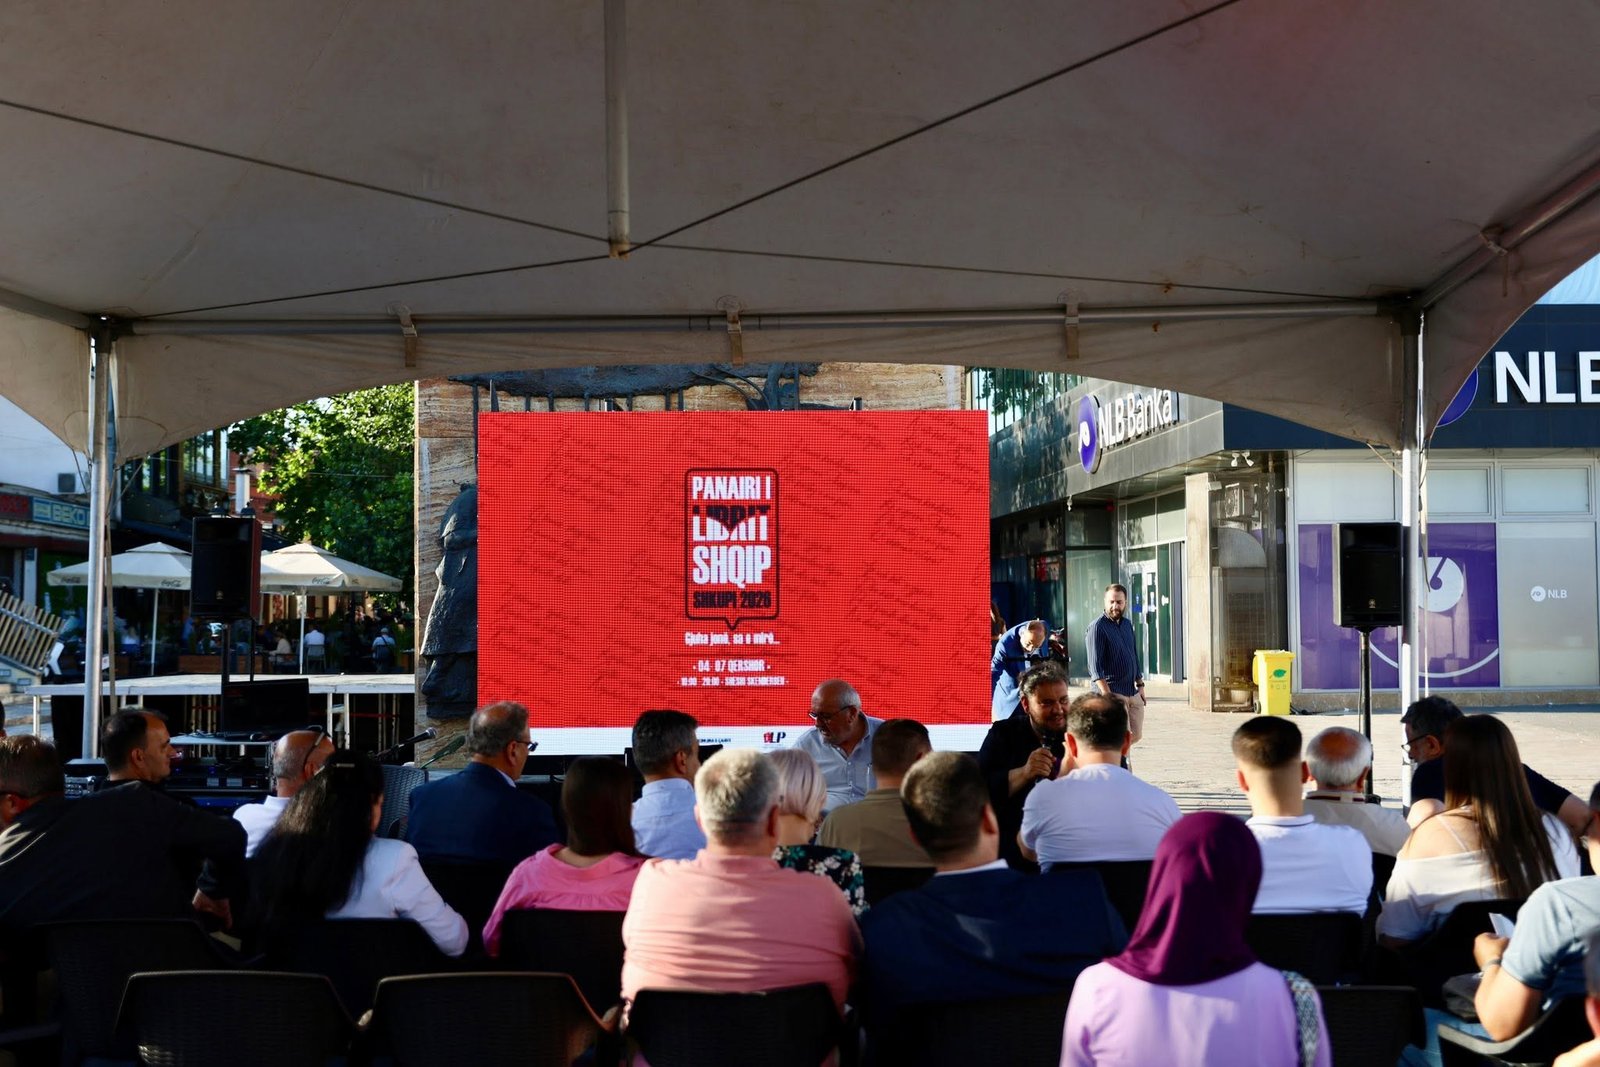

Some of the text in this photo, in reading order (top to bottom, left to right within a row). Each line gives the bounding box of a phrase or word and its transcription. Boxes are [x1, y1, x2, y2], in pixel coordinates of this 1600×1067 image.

[1098, 387, 1173, 449] NLB Banka
[692, 476, 771, 500] PANAIRI I
[692, 504, 771, 541] LIBRIT
[692, 545, 772, 589] SHQIP
[1547, 589, 1568, 599] NLB
